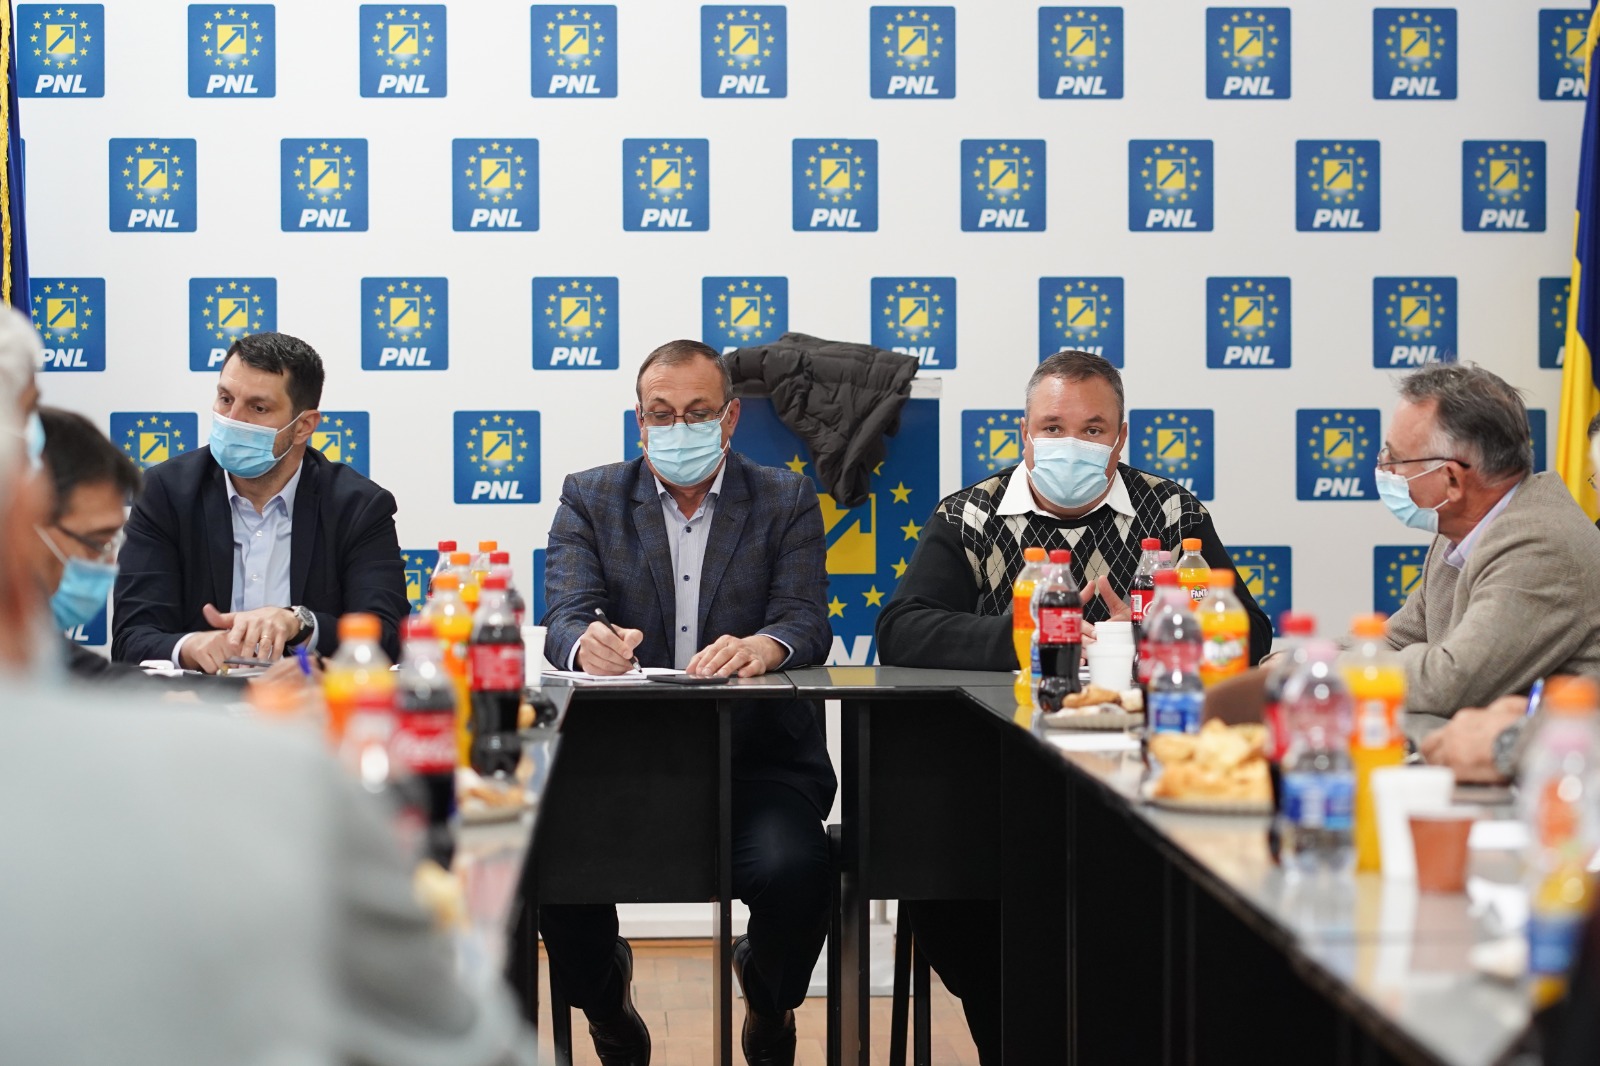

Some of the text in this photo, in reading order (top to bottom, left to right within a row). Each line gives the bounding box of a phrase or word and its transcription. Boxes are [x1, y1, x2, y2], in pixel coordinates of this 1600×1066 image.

[34, 74, 87, 94] PNL
[205, 74, 259, 94] PNL
[377, 74, 430, 94] PNL
[548, 74, 601, 94] PNL
[718, 74, 770, 95] PNL
[887, 75, 939, 95] PNL
[1055, 75, 1107, 95] PNL
[1222, 76, 1274, 96] PNL
[1389, 76, 1441, 96] PNL
[127, 208, 180, 228] PNL
[298, 208, 351, 228] PNL
[469, 208, 523, 228] PNL
[640, 208, 693, 228] PNL
[809, 207, 861, 228] PNL
[978, 208, 1030, 228] PNL
[1145, 208, 1197, 228] PNL
[1312, 208, 1364, 228] PNL
[1479, 209, 1529, 228] PNL
[378, 347, 431, 367] PNL
[549, 346, 602, 366] PNL
[1223, 345, 1275, 365] PNL
[1389, 345, 1442, 365] PNL
[471, 480, 524, 500] PNL
[1313, 477, 1364, 497] PNL
[1191, 588, 1209, 598] FANT
